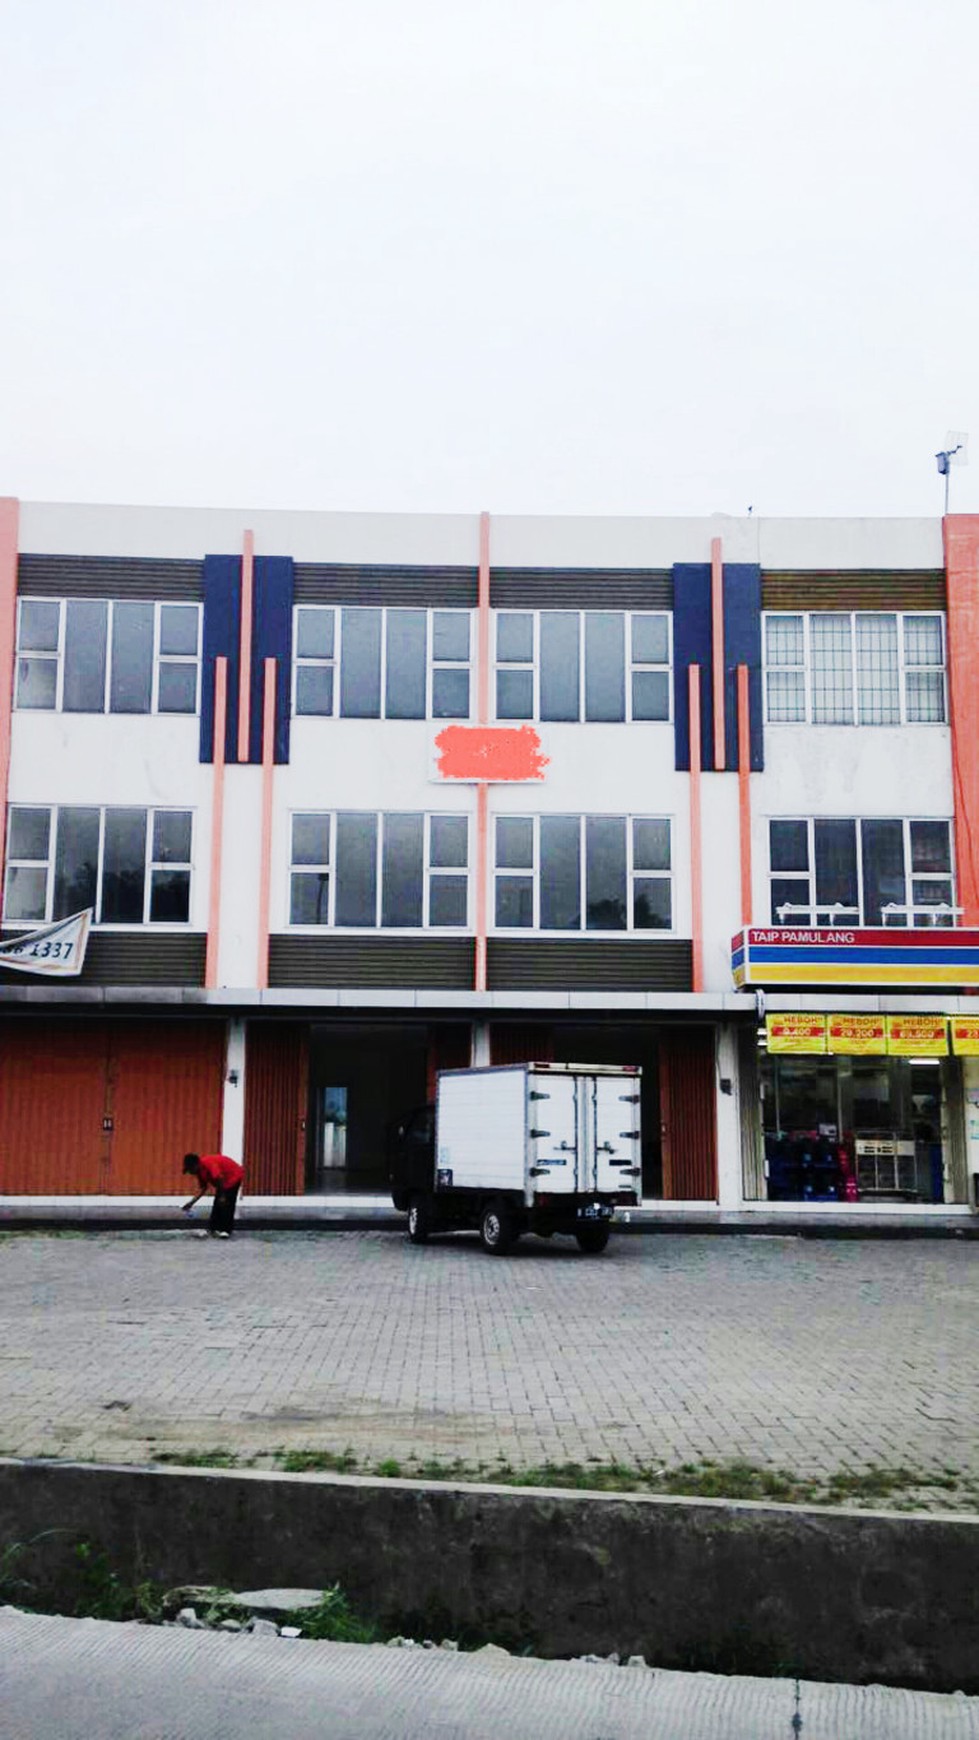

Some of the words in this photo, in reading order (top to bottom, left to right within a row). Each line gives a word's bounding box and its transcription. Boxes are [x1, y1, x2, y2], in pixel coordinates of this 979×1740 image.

[752, 931, 779, 942] TAIP
[782, 931, 855, 943] PAMULANG
[29, 942, 74, 959] 1337
